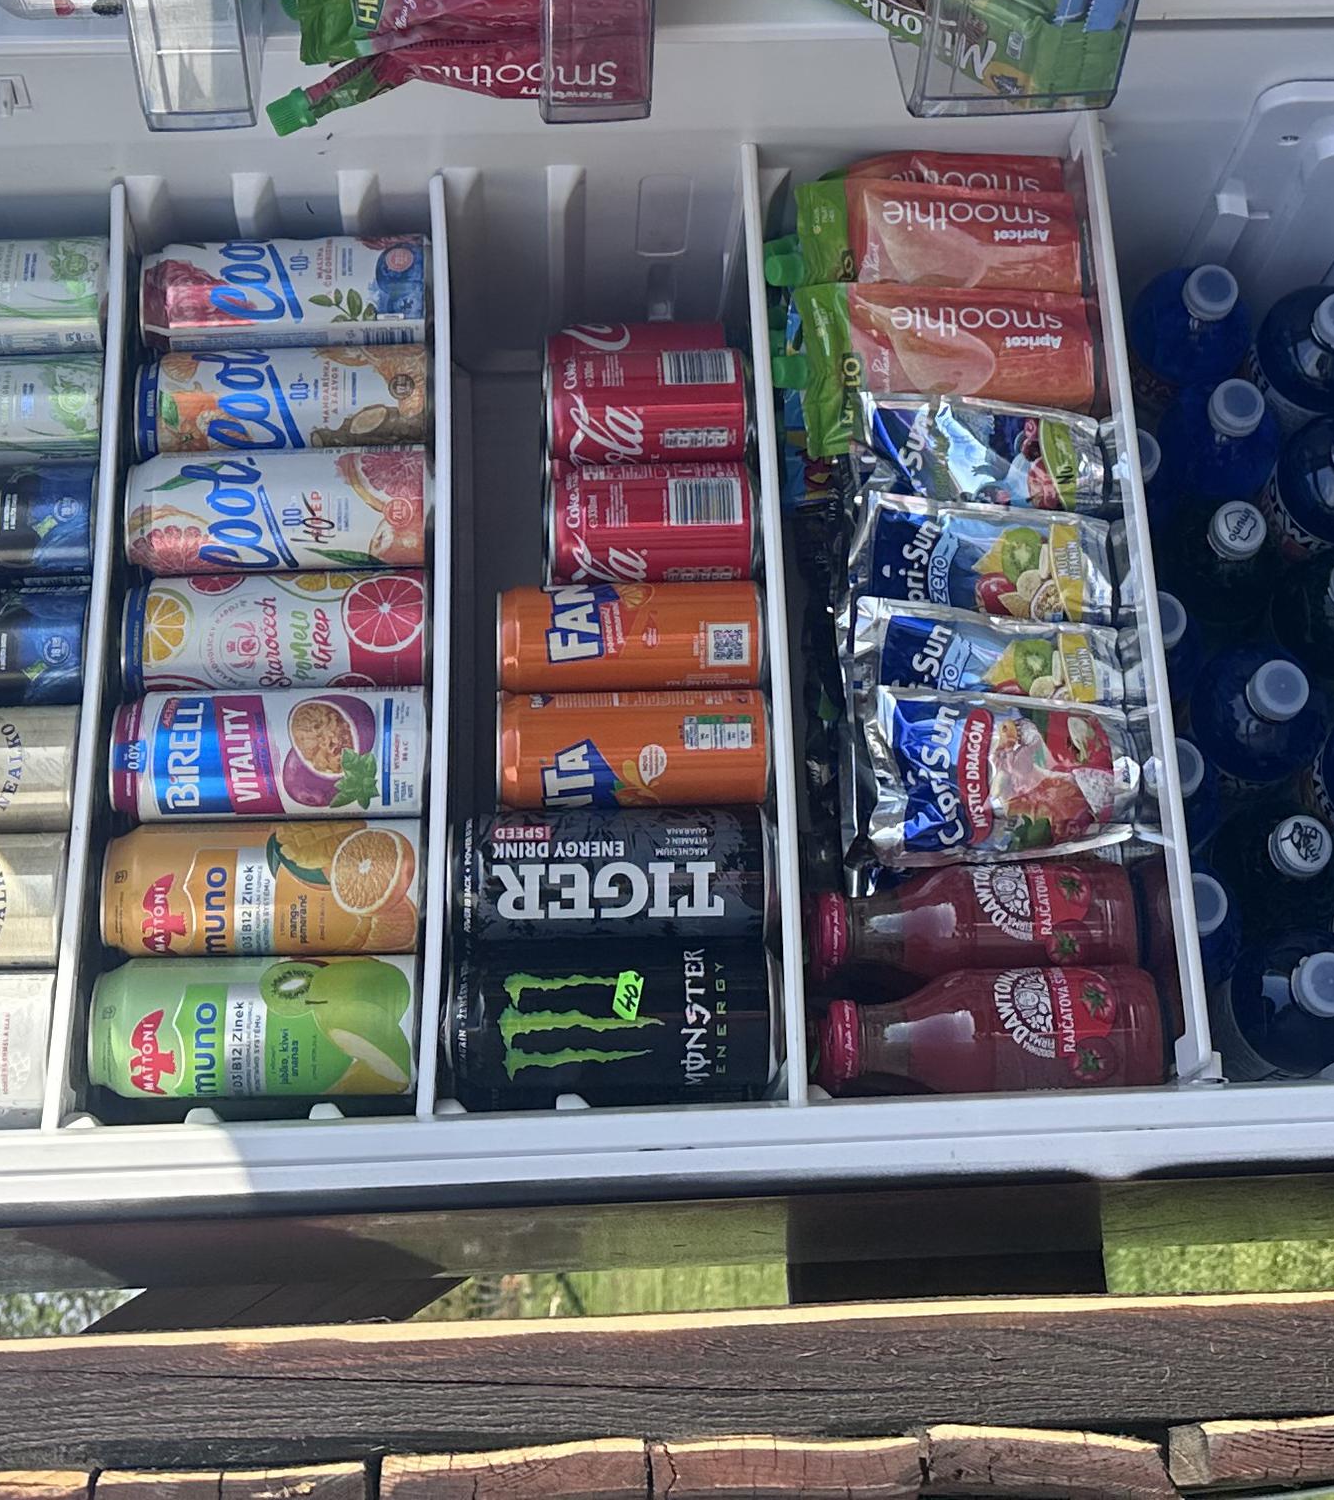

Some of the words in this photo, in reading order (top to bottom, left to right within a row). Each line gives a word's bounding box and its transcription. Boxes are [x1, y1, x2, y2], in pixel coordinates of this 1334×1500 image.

[881, 200, 1052, 230] smoothie
[992, 229, 1050, 242] Apricot
[890, 306, 1064, 337] smoothie
[1004, 335, 1063, 349] Apricot
[1227, 508, 1255, 542] imuno
[928, 555, 949, 602] zero
[254, 597, 292, 688] Staročech
[222, 707, 261, 802] VITALITY
[966, 720, 986, 780] DRAGON
[967, 781, 989, 828] MYSTIC
[491, 841, 551, 859] DRINK
[494, 826, 546, 840] SPEED
[555, 840, 625, 857] ENERGY
[242, 865, 254, 905] Zinek
[463, 875, 472, 898] BACK
[492, 861, 725, 919] TIGER
[153, 886, 166, 951] MATTONI
[242, 911, 252, 932] B12
[289, 903, 299, 938] mango
[298, 895, 309, 944] pomeranč
[232, 1001, 244, 1042] Zinek
[680, 949, 711, 1086] MONSTER
[714, 962, 727, 1074] ENERGY
[1053, 986, 1076, 1052] RAJČATOVÁ
[141, 1022, 156, 1091] MATTONI
[231, 1048, 243, 1071] B12
[278, 1028, 289, 1053] kiwi
[291, 1040, 299, 1077] ananas
